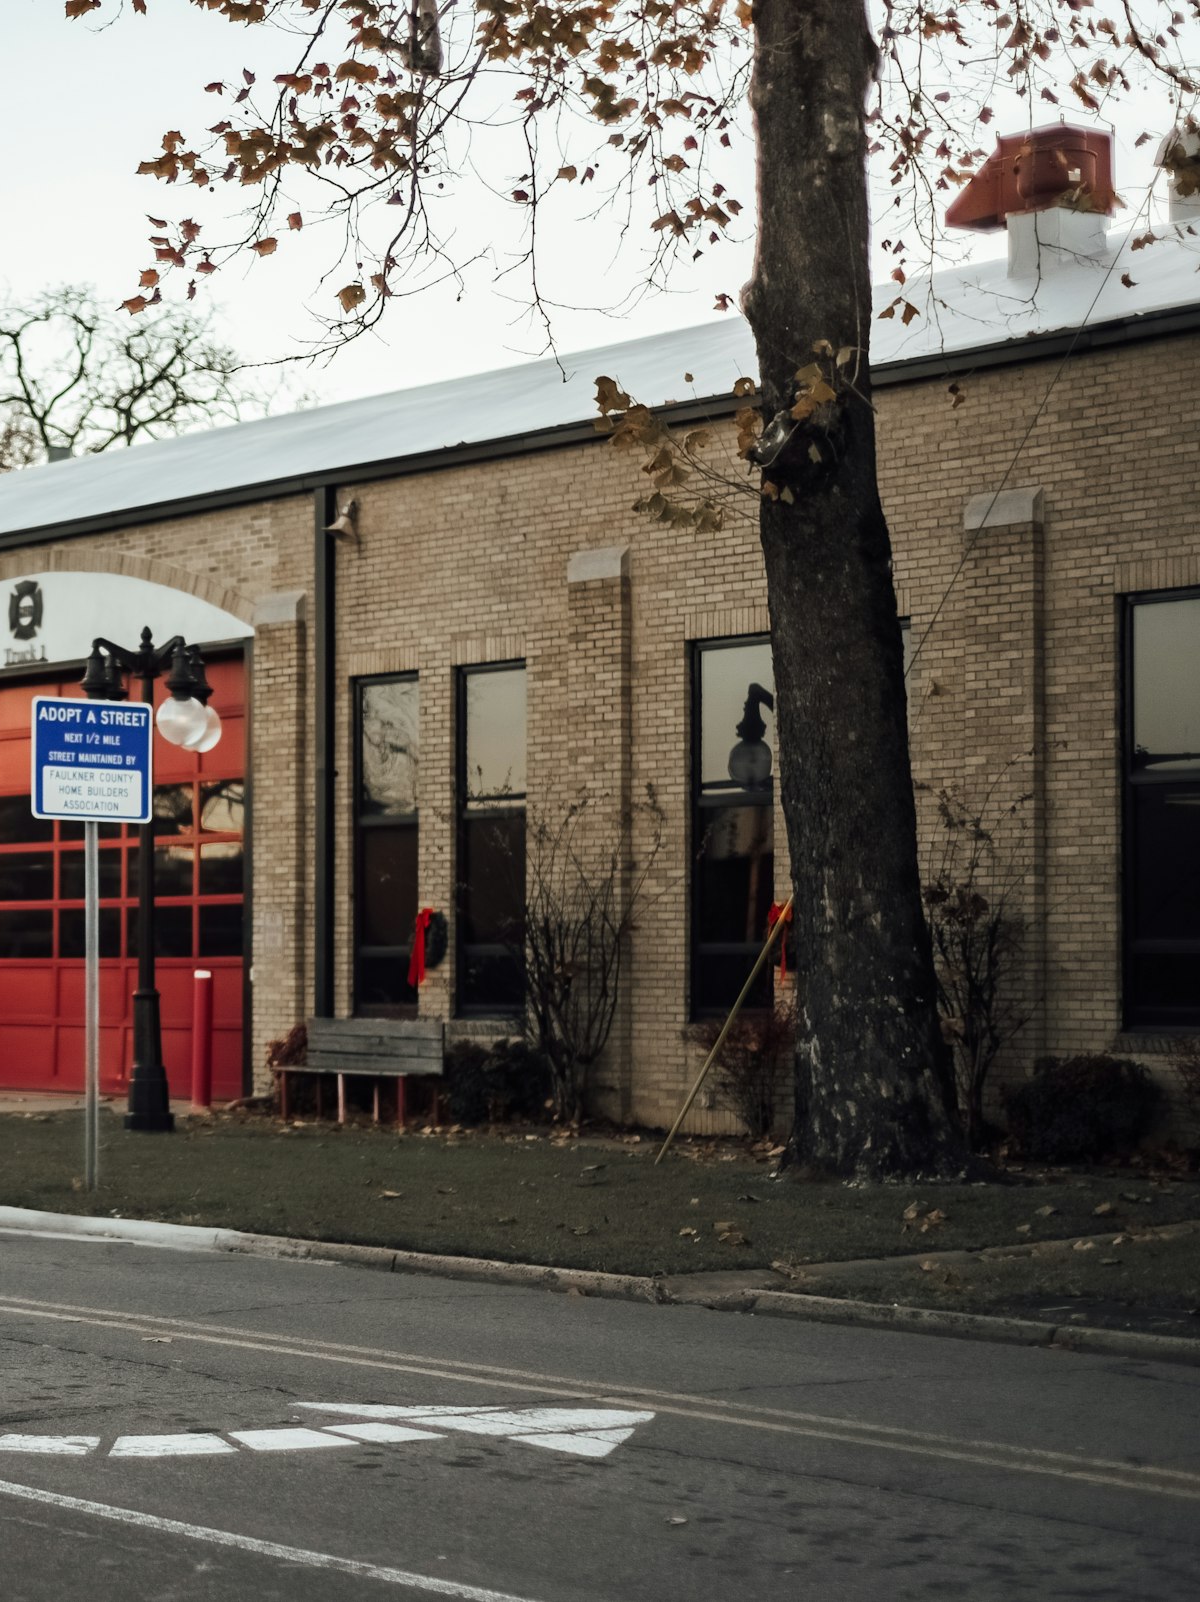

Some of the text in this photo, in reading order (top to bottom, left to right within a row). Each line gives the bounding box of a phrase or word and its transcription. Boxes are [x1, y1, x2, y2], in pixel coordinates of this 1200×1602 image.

[39, 707, 147, 727] ADOPT A STREET
[64, 732, 120, 746] NEXT 1/2 MILE
[48, 751, 136, 765] STREET MAINTAINED BY
[49, 770, 134, 783] FAULKNER COUNTY
[59, 785, 129, 798] HOME BUILDERS
[63, 800, 119, 812] ASSOCIATION
